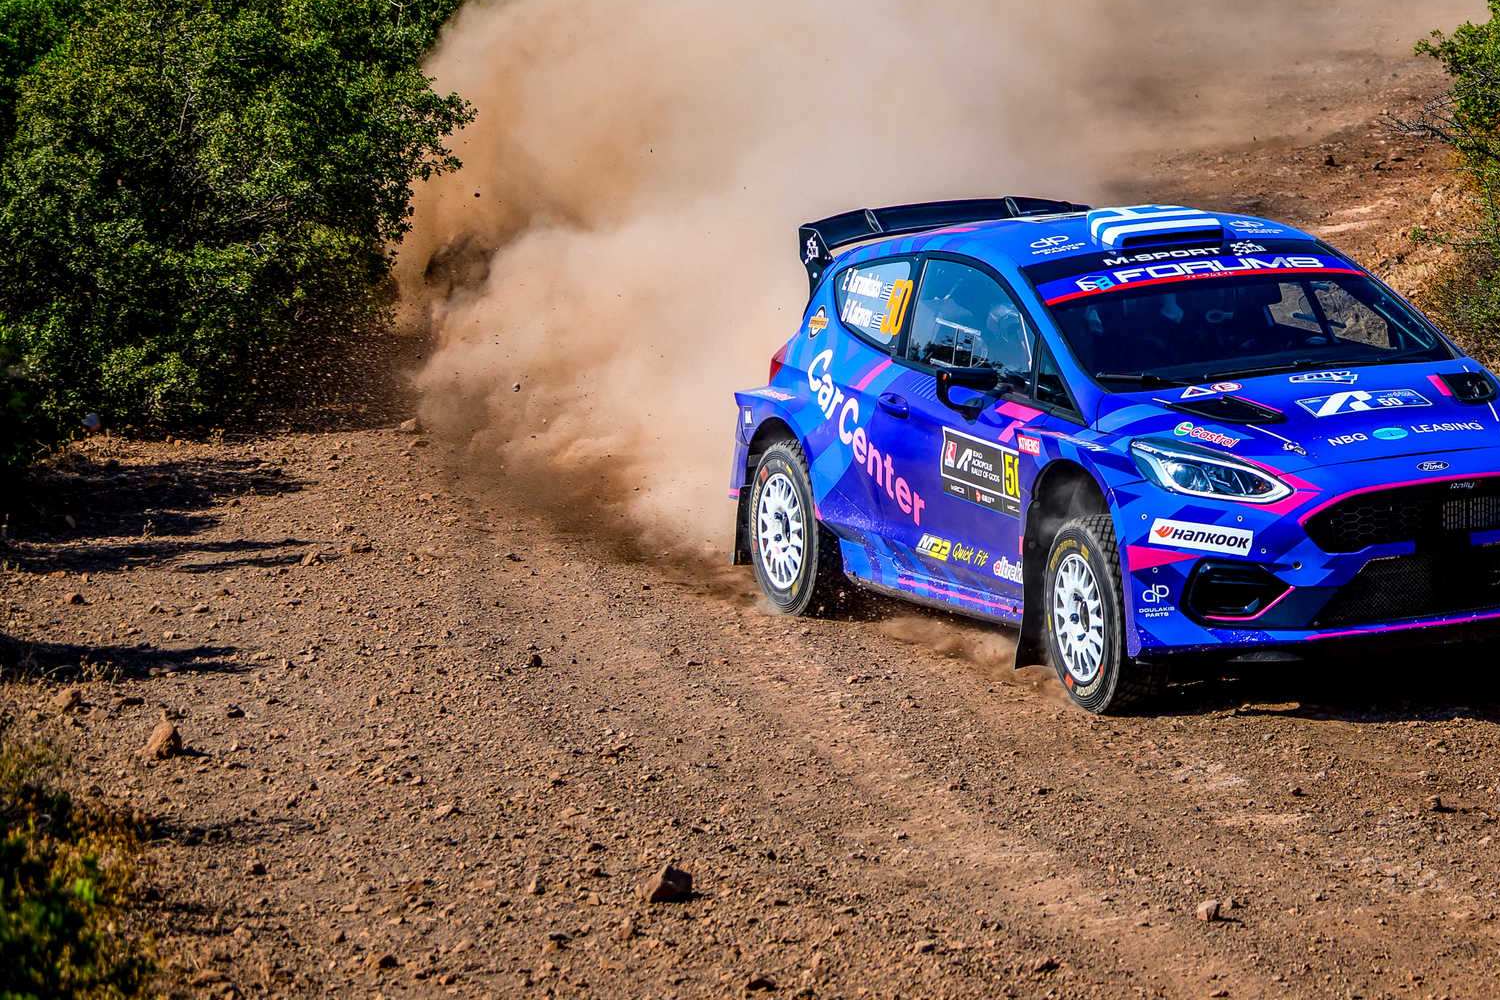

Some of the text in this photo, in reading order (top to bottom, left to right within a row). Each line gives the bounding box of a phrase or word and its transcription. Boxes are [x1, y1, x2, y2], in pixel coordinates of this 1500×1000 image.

[1103, 247, 1221, 267] M-SPORT
[1112, 256, 1324, 284] FORUM8
[880, 279, 914, 336] 50
[1376, 397, 1404, 407] 50
[1189, 427, 1241, 449] Castrol
[1327, 421, 1484, 447] NBG LEASING
[1170, 527, 1251, 549] HANKOOK
